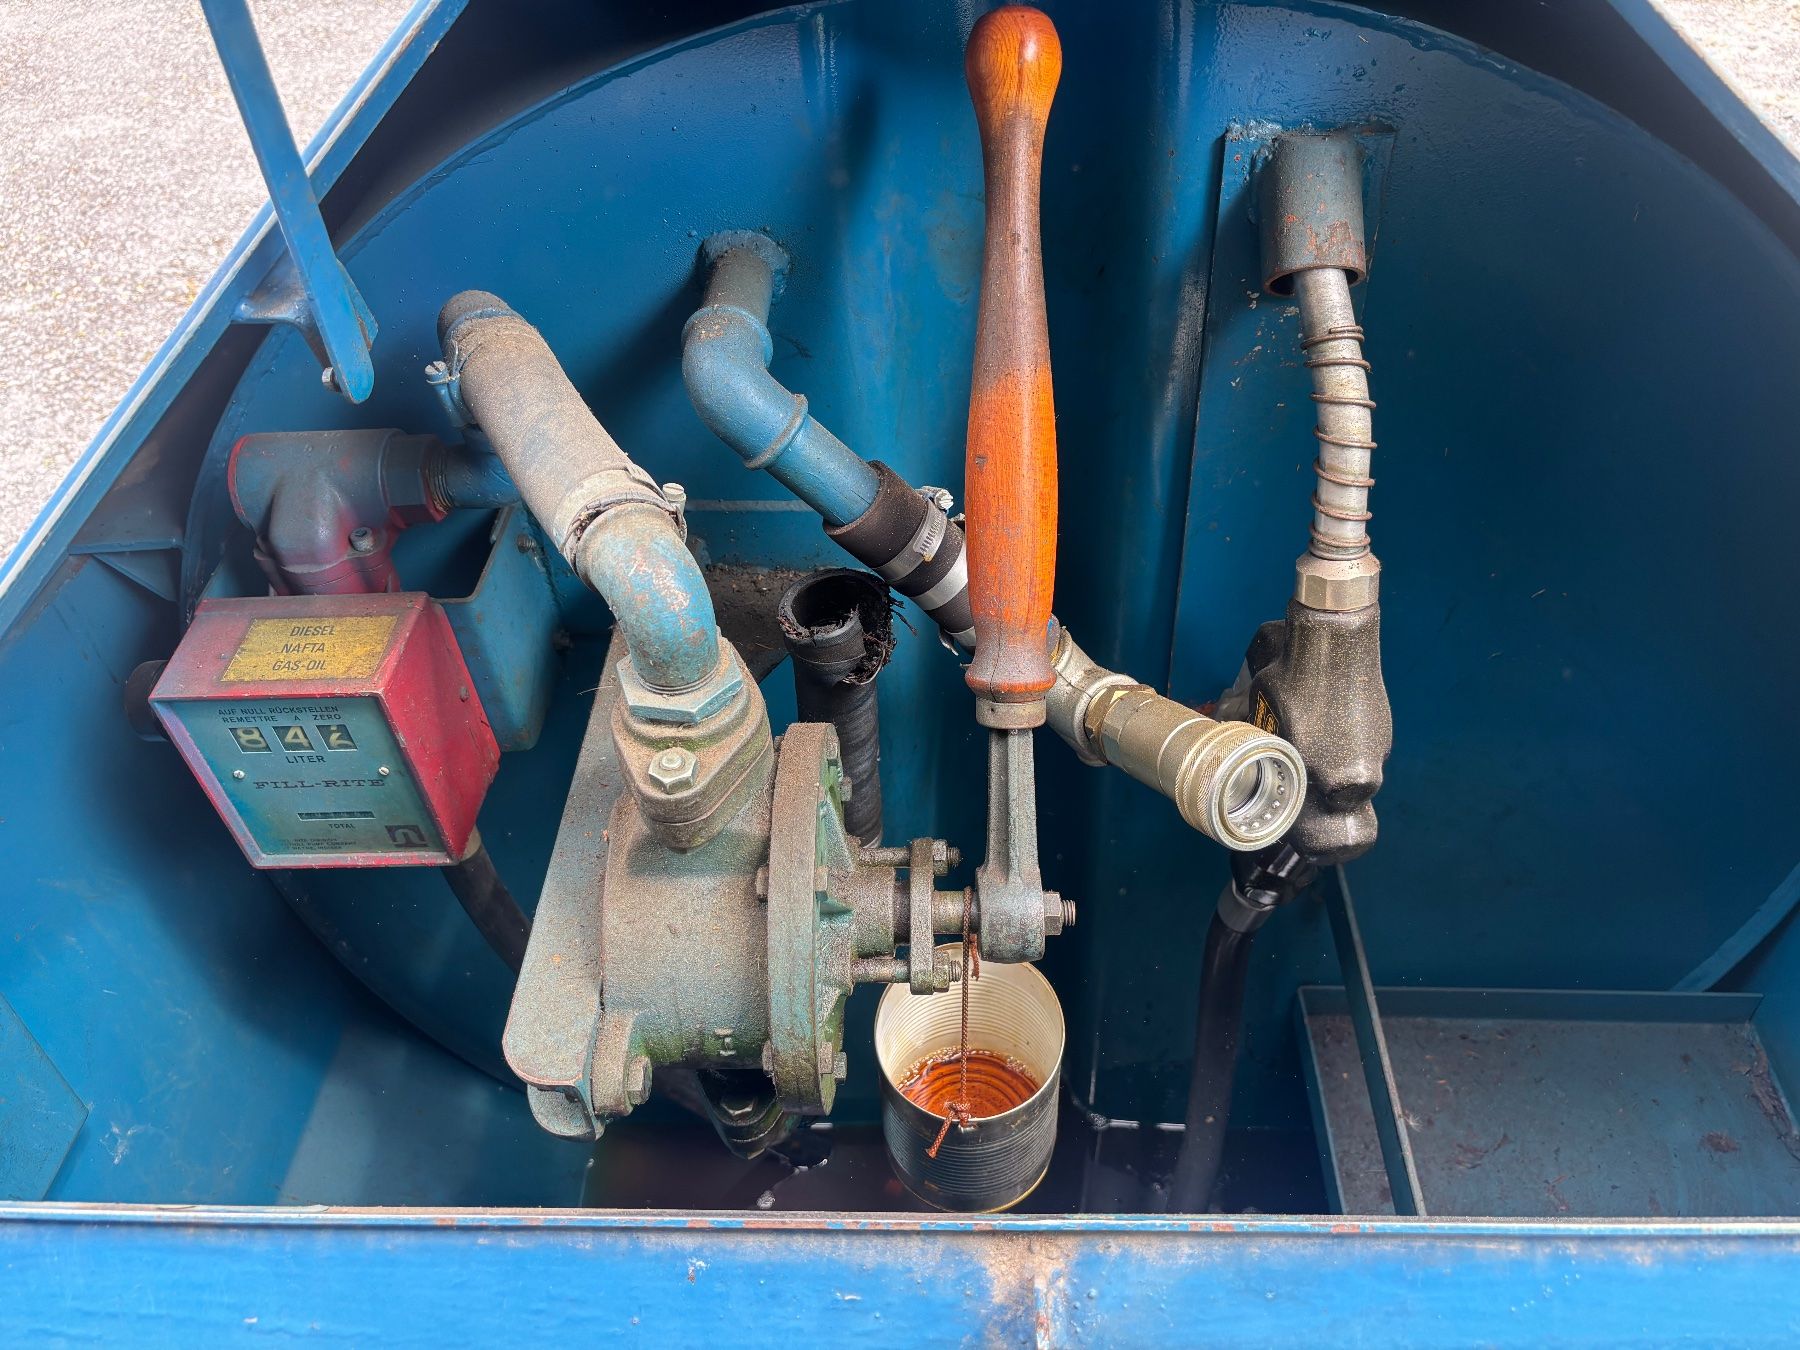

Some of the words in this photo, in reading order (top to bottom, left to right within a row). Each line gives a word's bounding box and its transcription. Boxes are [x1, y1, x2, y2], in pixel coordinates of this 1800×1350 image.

[290, 625, 335, 637] DIESEL
[280, 642, 325, 653] NAFTA
[272, 660, 327, 671] GAS-OIL
[218, 708, 237, 716] AUF
[241, 707, 266, 715] NULL
[268, 705, 339, 714] RÜCKSTELLEN
[222, 715, 278, 723] REMETTRE
[285, 755, 326, 764] LITER
[253, 778, 386, 790] FILL-RITE
